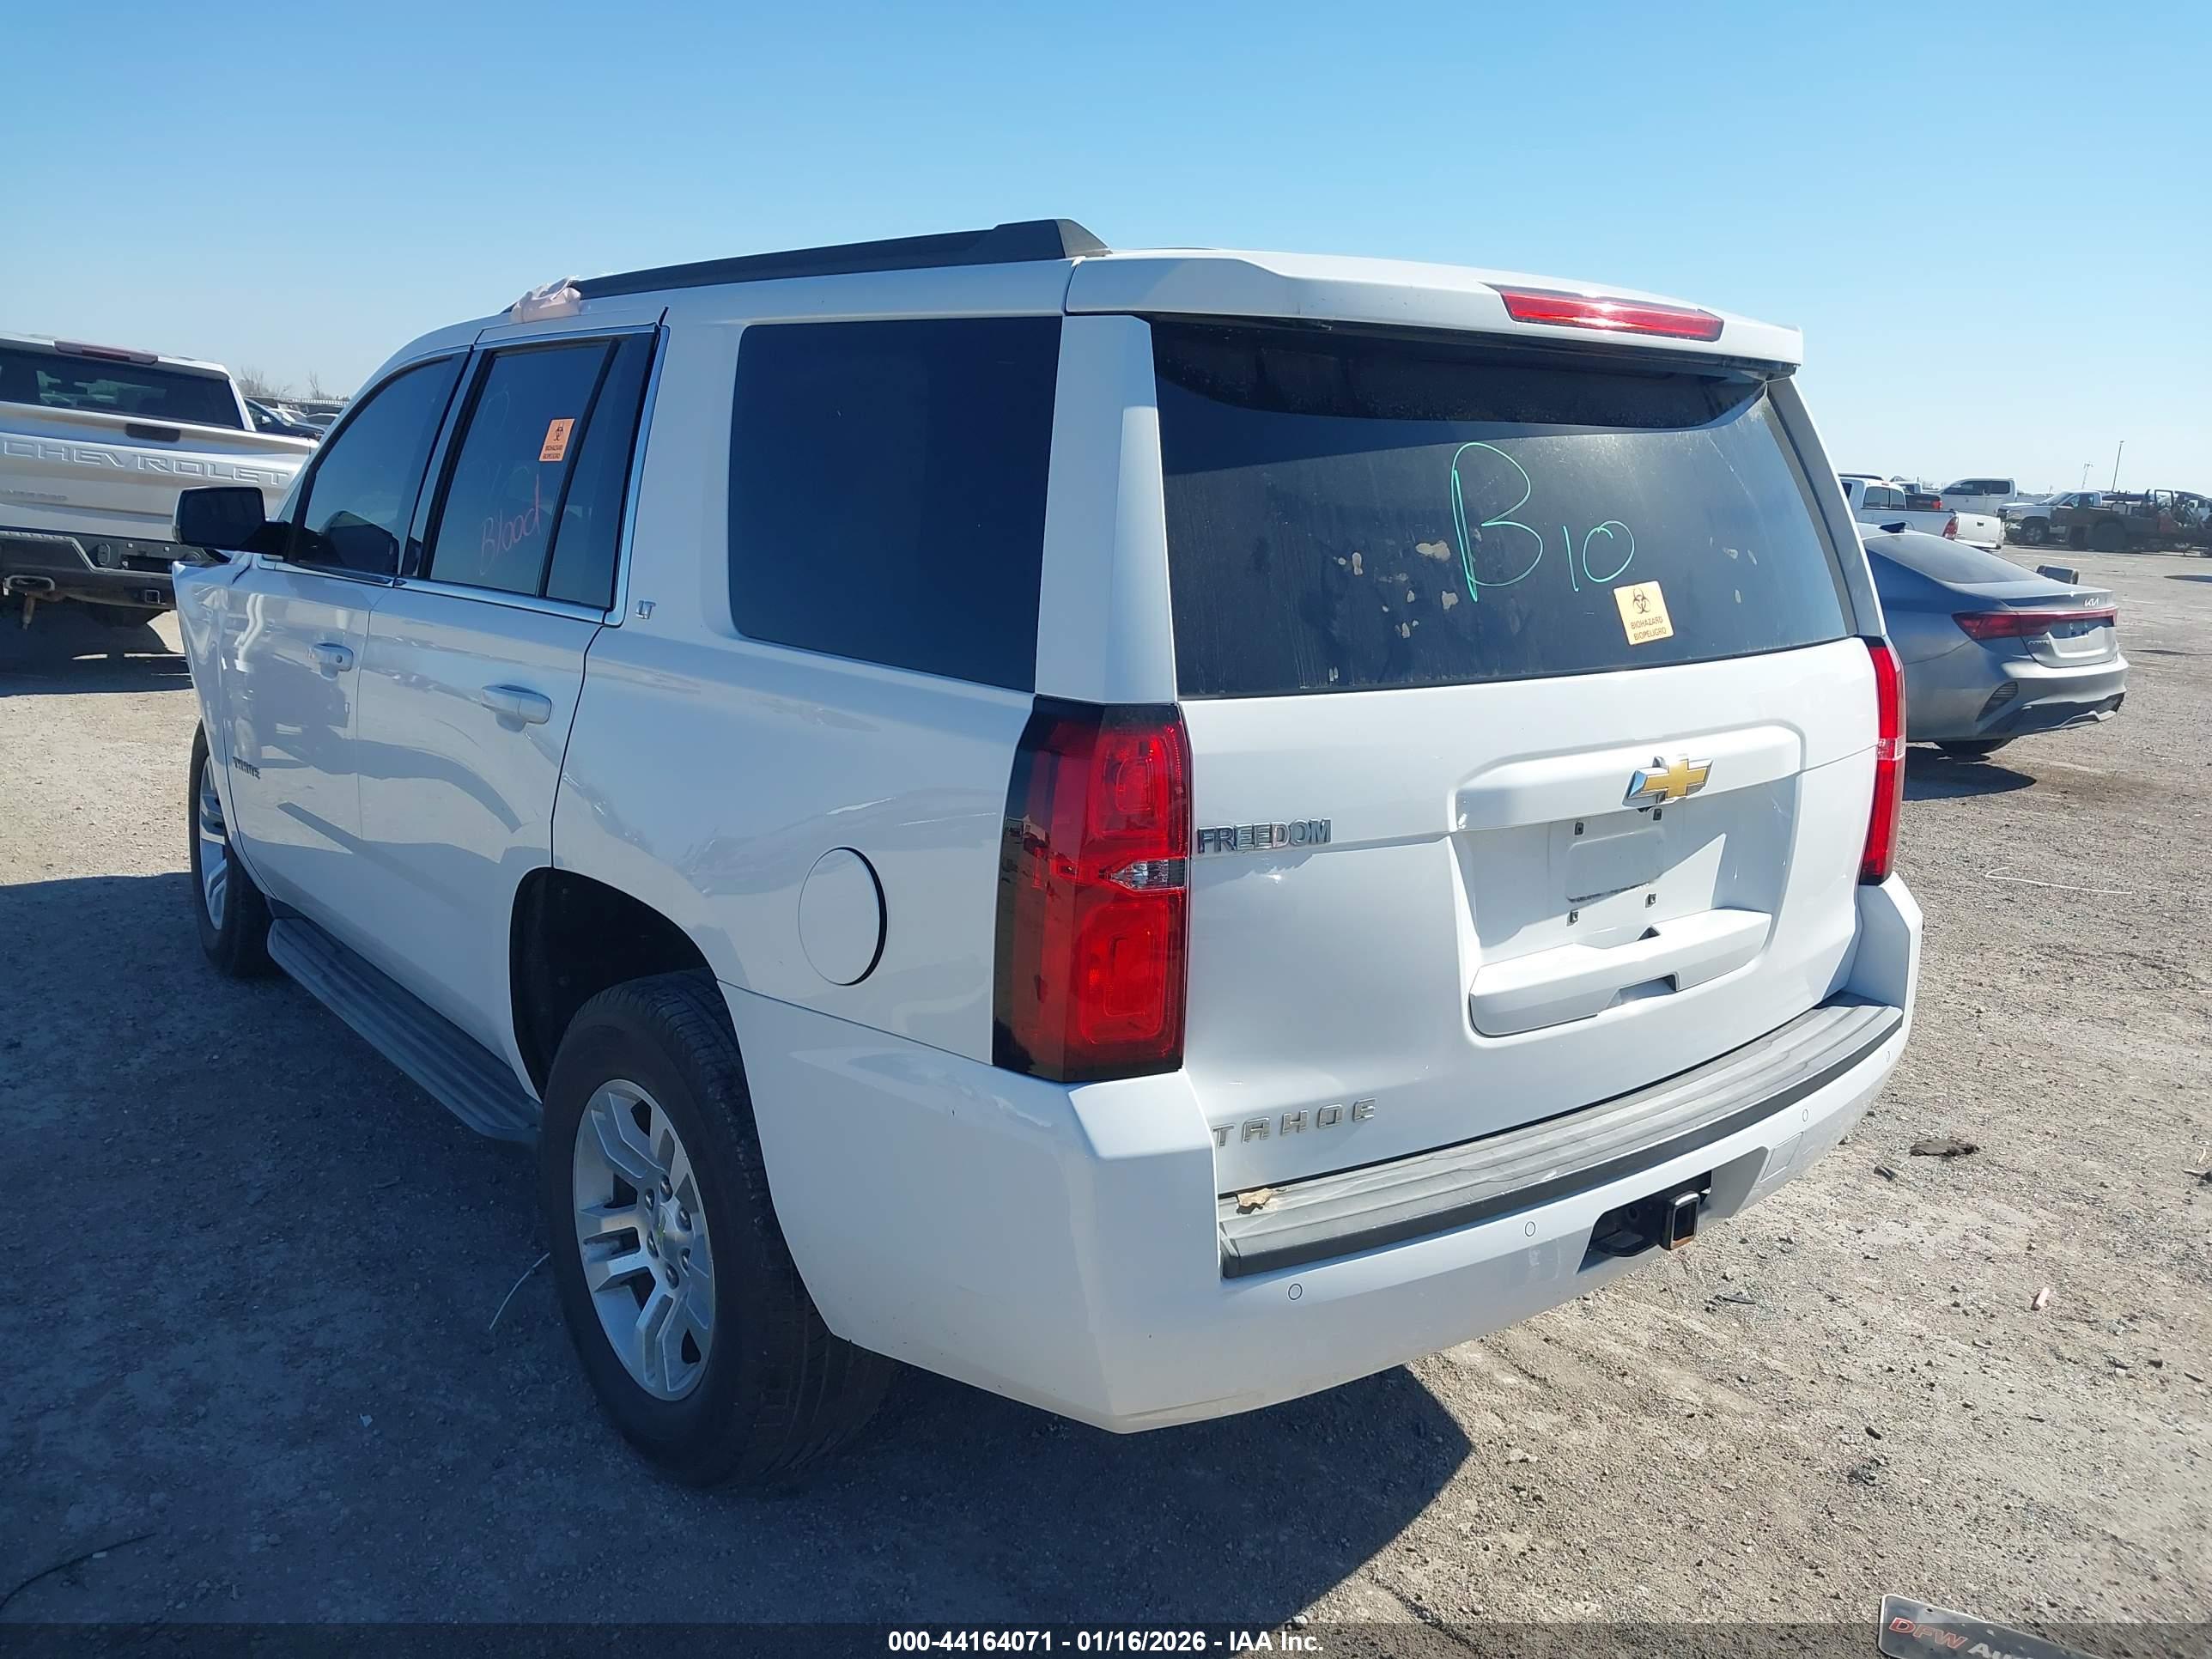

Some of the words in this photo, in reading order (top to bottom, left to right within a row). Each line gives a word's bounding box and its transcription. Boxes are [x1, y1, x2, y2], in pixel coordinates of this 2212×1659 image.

[3, 441, 289, 486] CHEVROLET
[479, 473, 541, 576] Blood
[635, 599, 657, 619] LT
[1630, 616, 1663, 629] BIOHAZARD
[1633, 626, 1667, 641] BIOPELIGRO
[1197, 817, 1332, 854] FREEDOM
[1211, 1097, 1376, 1148] TAHOE
[1889, 1616, 1969, 1650] DFW
